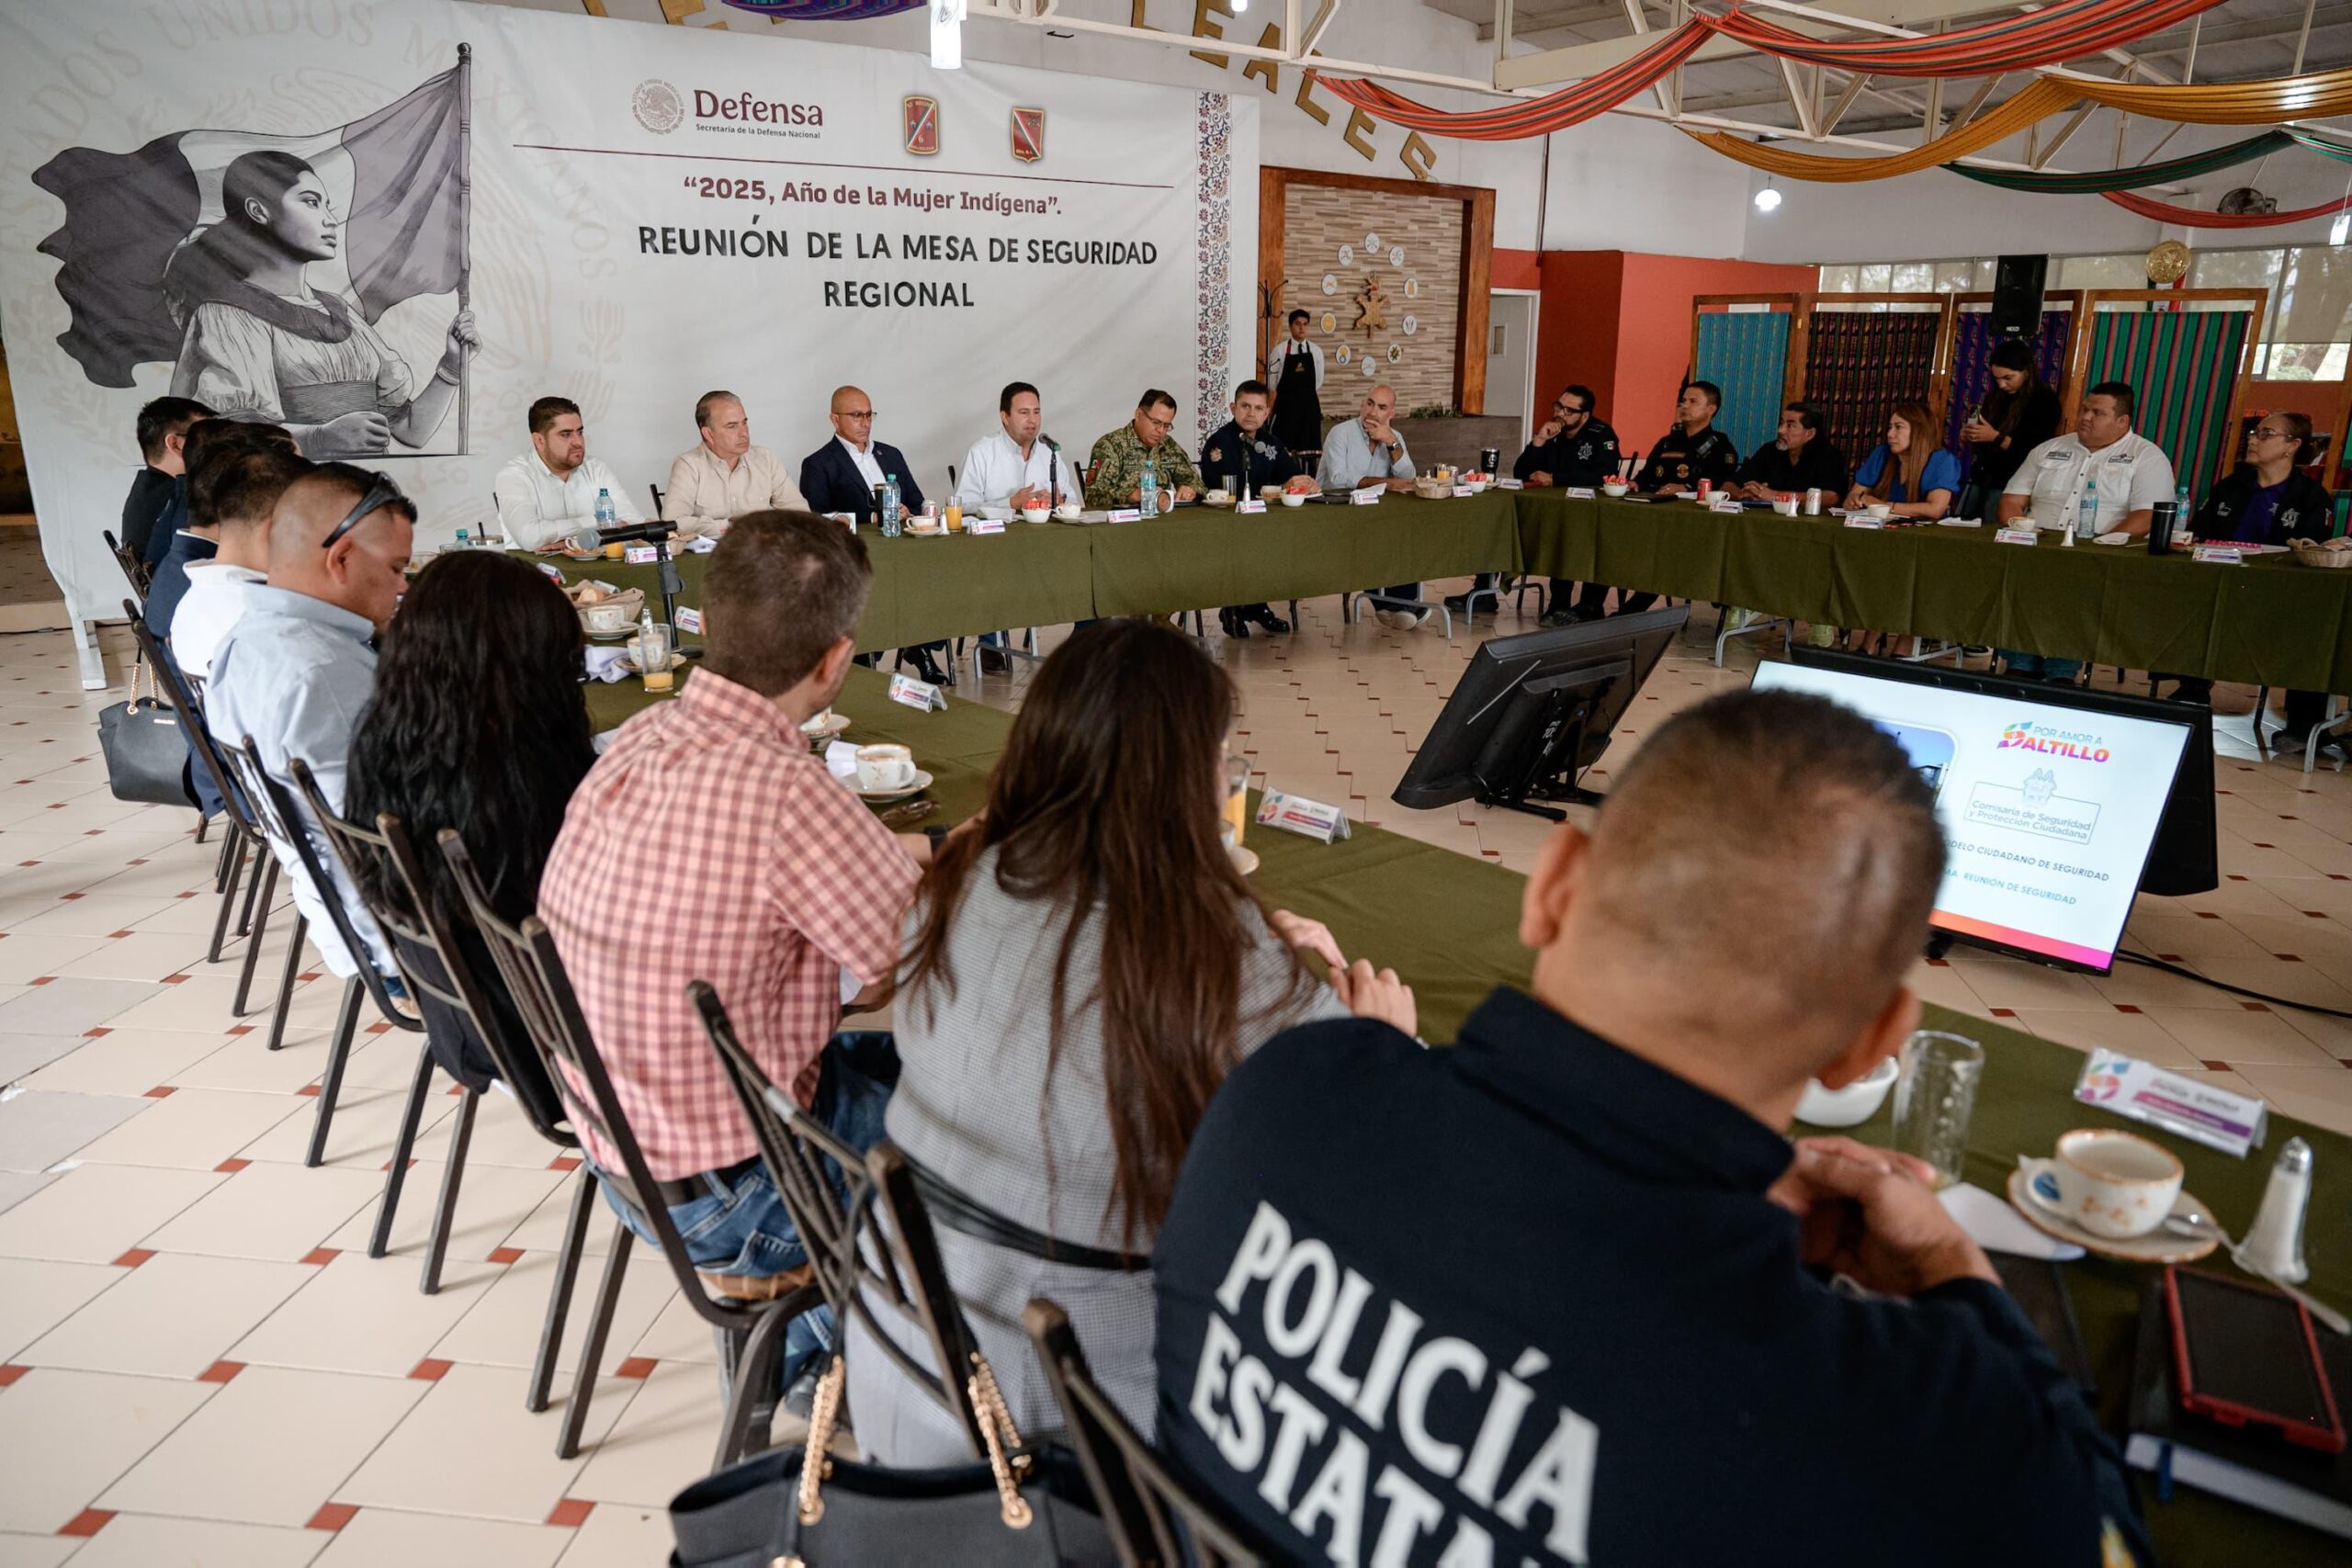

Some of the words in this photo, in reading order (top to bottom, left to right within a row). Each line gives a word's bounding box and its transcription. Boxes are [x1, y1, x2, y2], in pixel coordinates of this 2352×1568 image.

[694, 89, 823, 126] Defensa
[695, 123, 735, 133] Secretaría
[757, 129, 786, 137] Defensa
[788, 130, 820, 139] Nacional
[782, 182, 828, 203] Año
[833, 185, 861, 205] de
[867, 186, 888, 207] la
[893, 187, 955, 213] Mujer
[639, 214, 789, 258] REUNIÓN
[808, 231, 842, 259] DE
[856, 233, 892, 259] LA
[903, 234, 978, 262] MESA
[989, 238, 1019, 263] DE
[1026, 239, 1158, 265] SEGURIDAD
[824, 281, 975, 308] REGIONAL
[2033, 726, 2057, 738] POR
[2059, 730, 2093, 743] AMOR
[2095, 737, 2102, 745] A
[2022, 810, 2035, 819] de
[2038, 813, 2092, 831] Seguridad
[2032, 821, 2087, 840] Ciudadana
[1944, 838, 1974, 852] ODELO
[1977, 845, 2036, 865] CIUDADANO
[2038, 859, 2051, 869] DE
[2052, 863, 2109, 882] SEGURIDAD
[2007, 882, 2019, 892] DE
[2021, 886, 2077, 905] SEGURIDAD
[1215, 1200, 1600, 1564] POLICÍA
[1190, 1312, 1541, 1568] ESTAT
